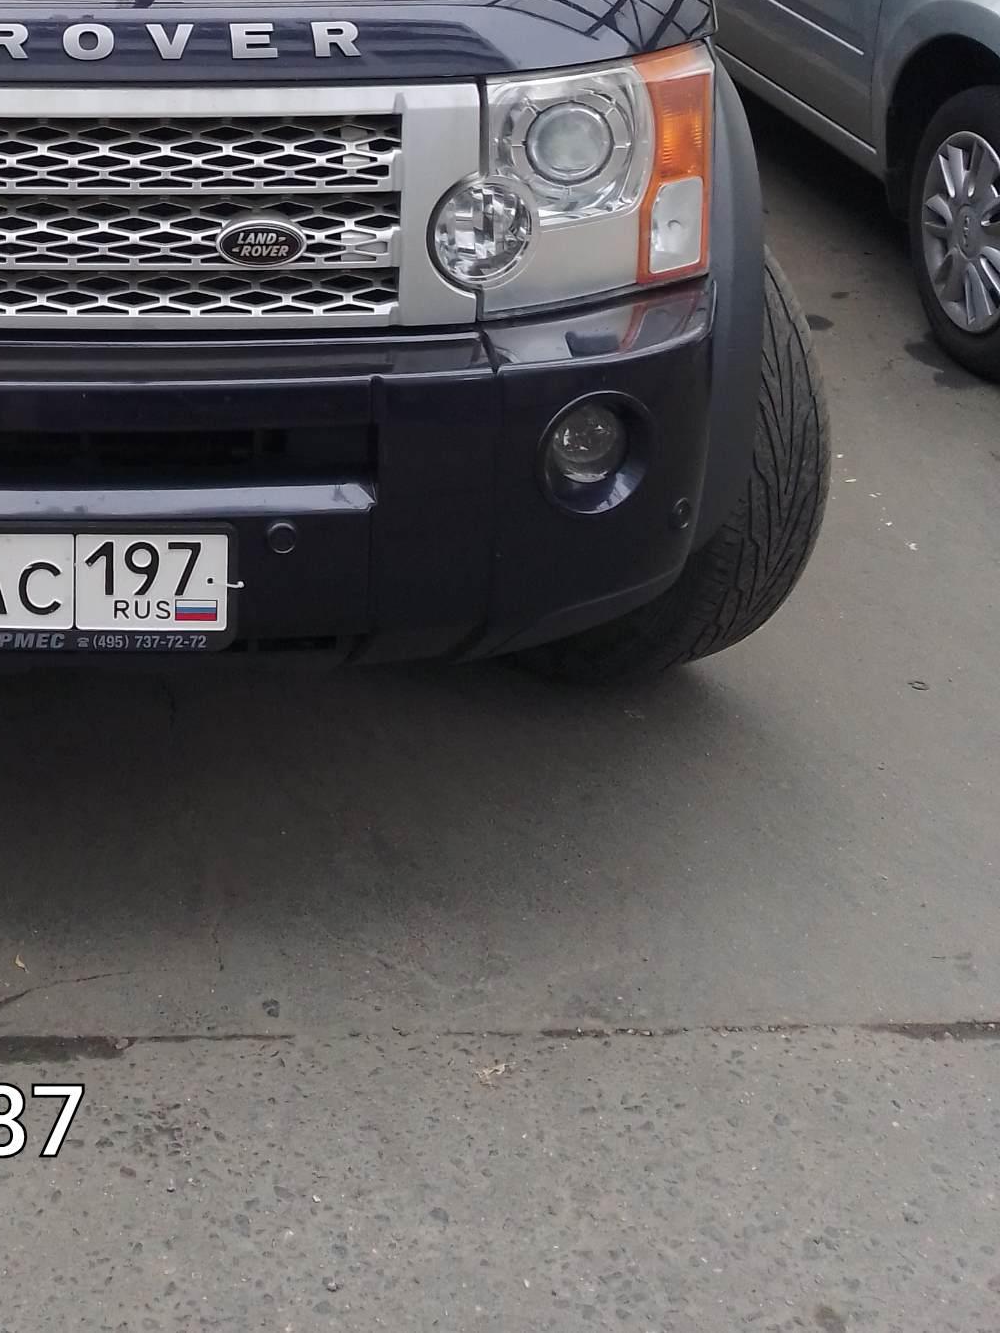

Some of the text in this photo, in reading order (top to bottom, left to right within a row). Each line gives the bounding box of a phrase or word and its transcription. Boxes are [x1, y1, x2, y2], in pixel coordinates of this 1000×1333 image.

[237, 232, 277, 244] LAND
[240, 245, 289, 257] ROVER
[83, 541, 202, 596] 197
[113, 599, 171, 620] RUS
[93, 635, 207, 649] (495) 737-72-72
